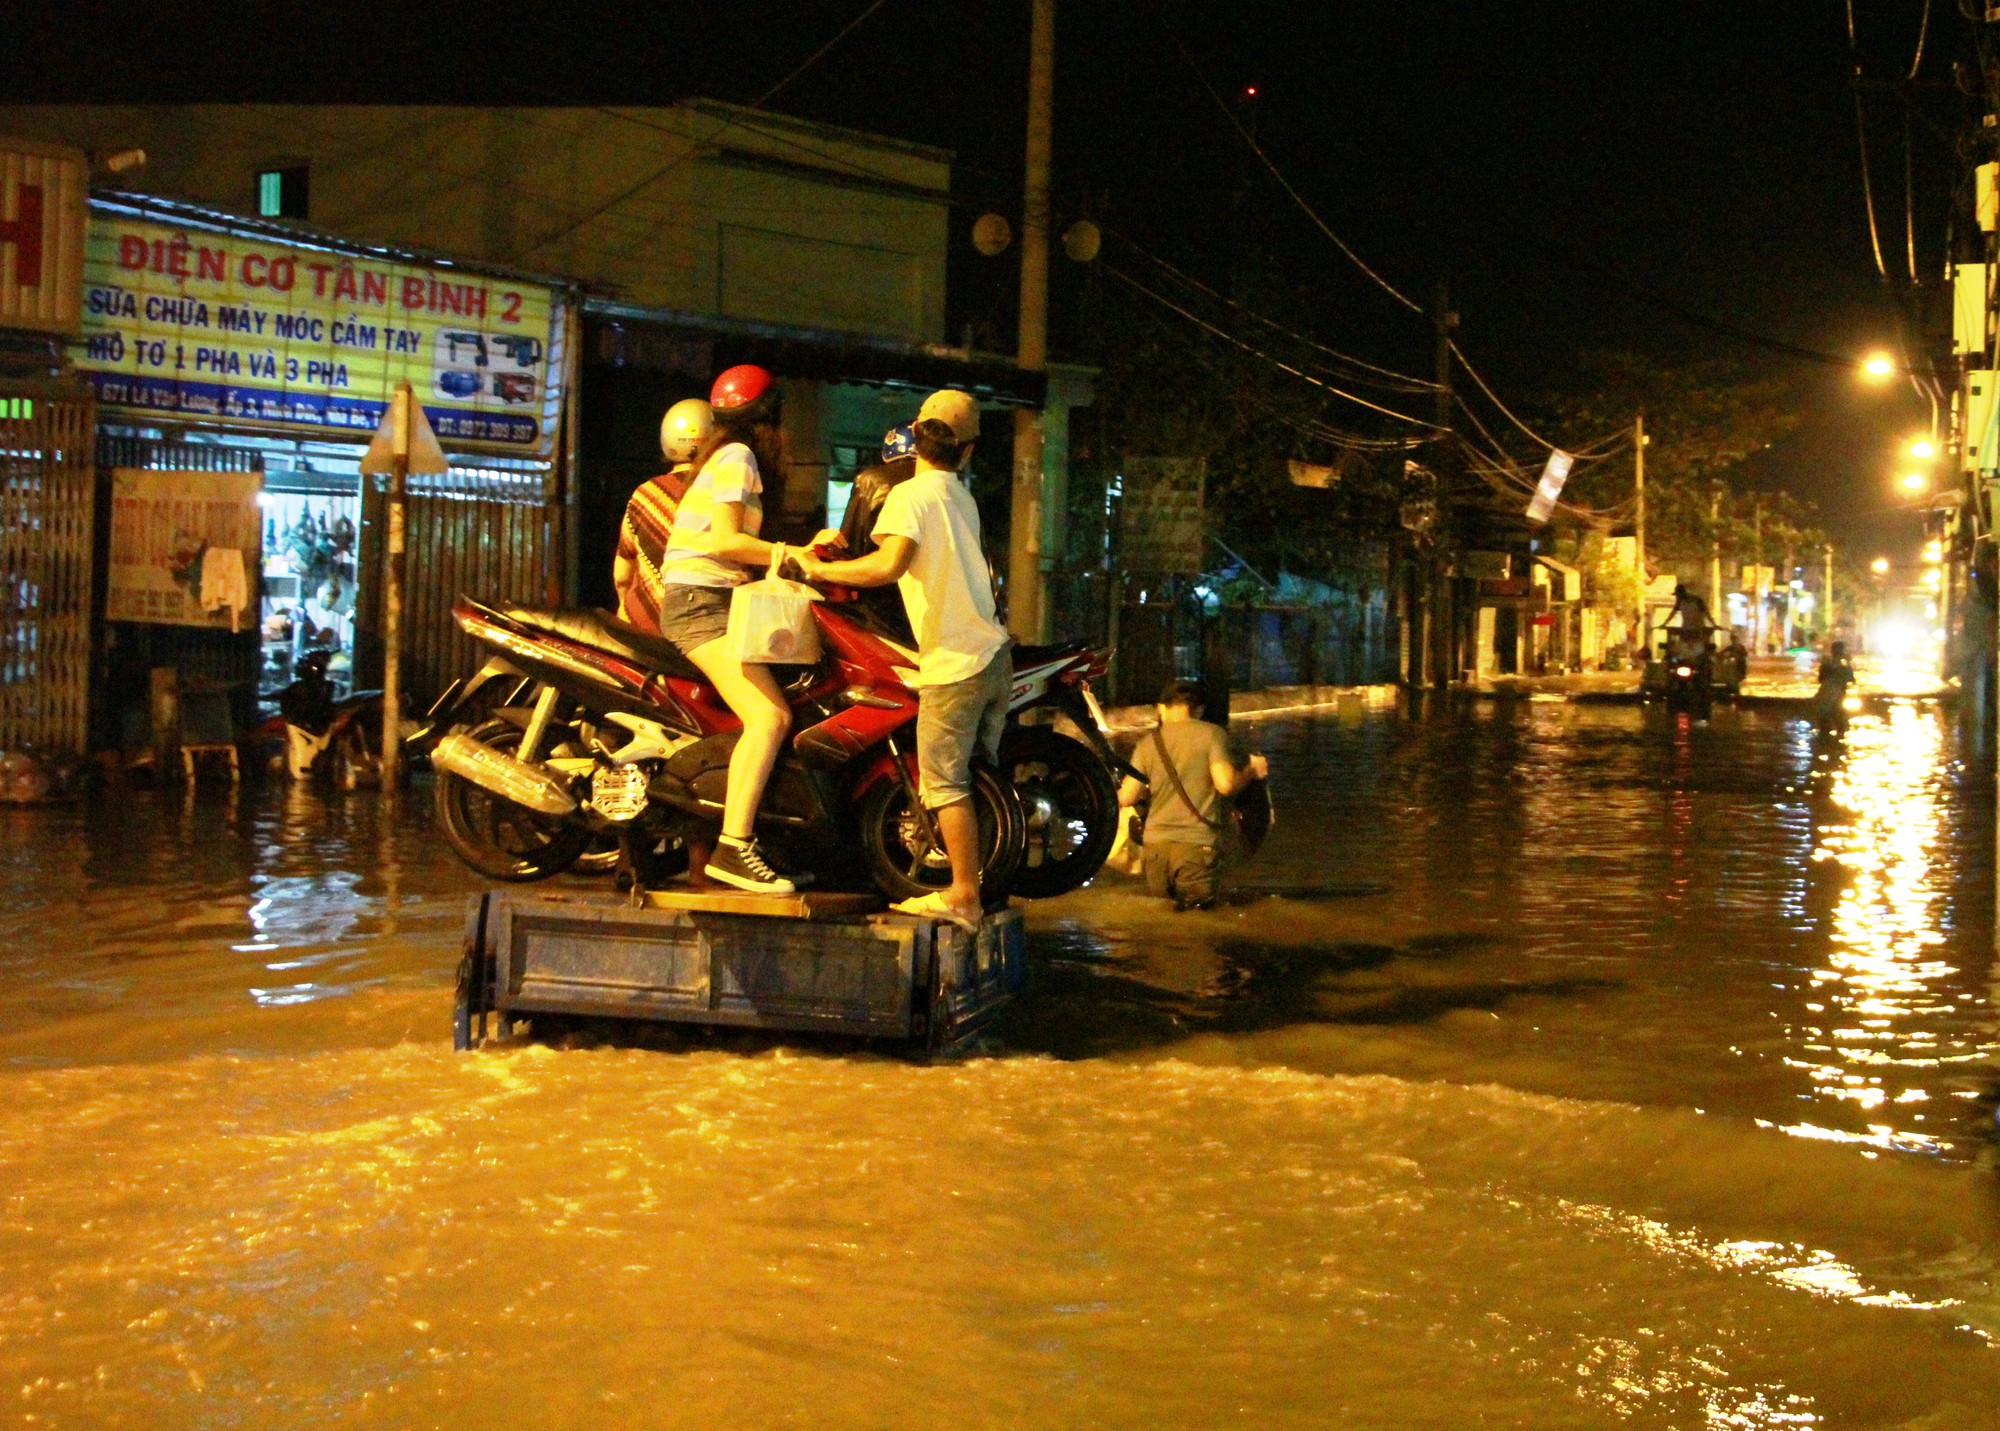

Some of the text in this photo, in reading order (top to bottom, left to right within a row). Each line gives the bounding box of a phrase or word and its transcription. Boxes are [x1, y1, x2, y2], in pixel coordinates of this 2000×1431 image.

[119, 231, 522, 322] ĐIỆN CƠ TÂN BÌNH 2
[218, 303, 267, 333] MÁY
[276, 310, 323, 341] MÓC
[331, 313, 376, 348] CẦM
[384, 328, 421, 353] TAY
[175, 345, 185, 369] 1
[196, 347, 240, 375] PHA
[249, 349, 276, 379] VÀ
[286, 358, 298, 381] 3
[307, 360, 348, 386] PHA
